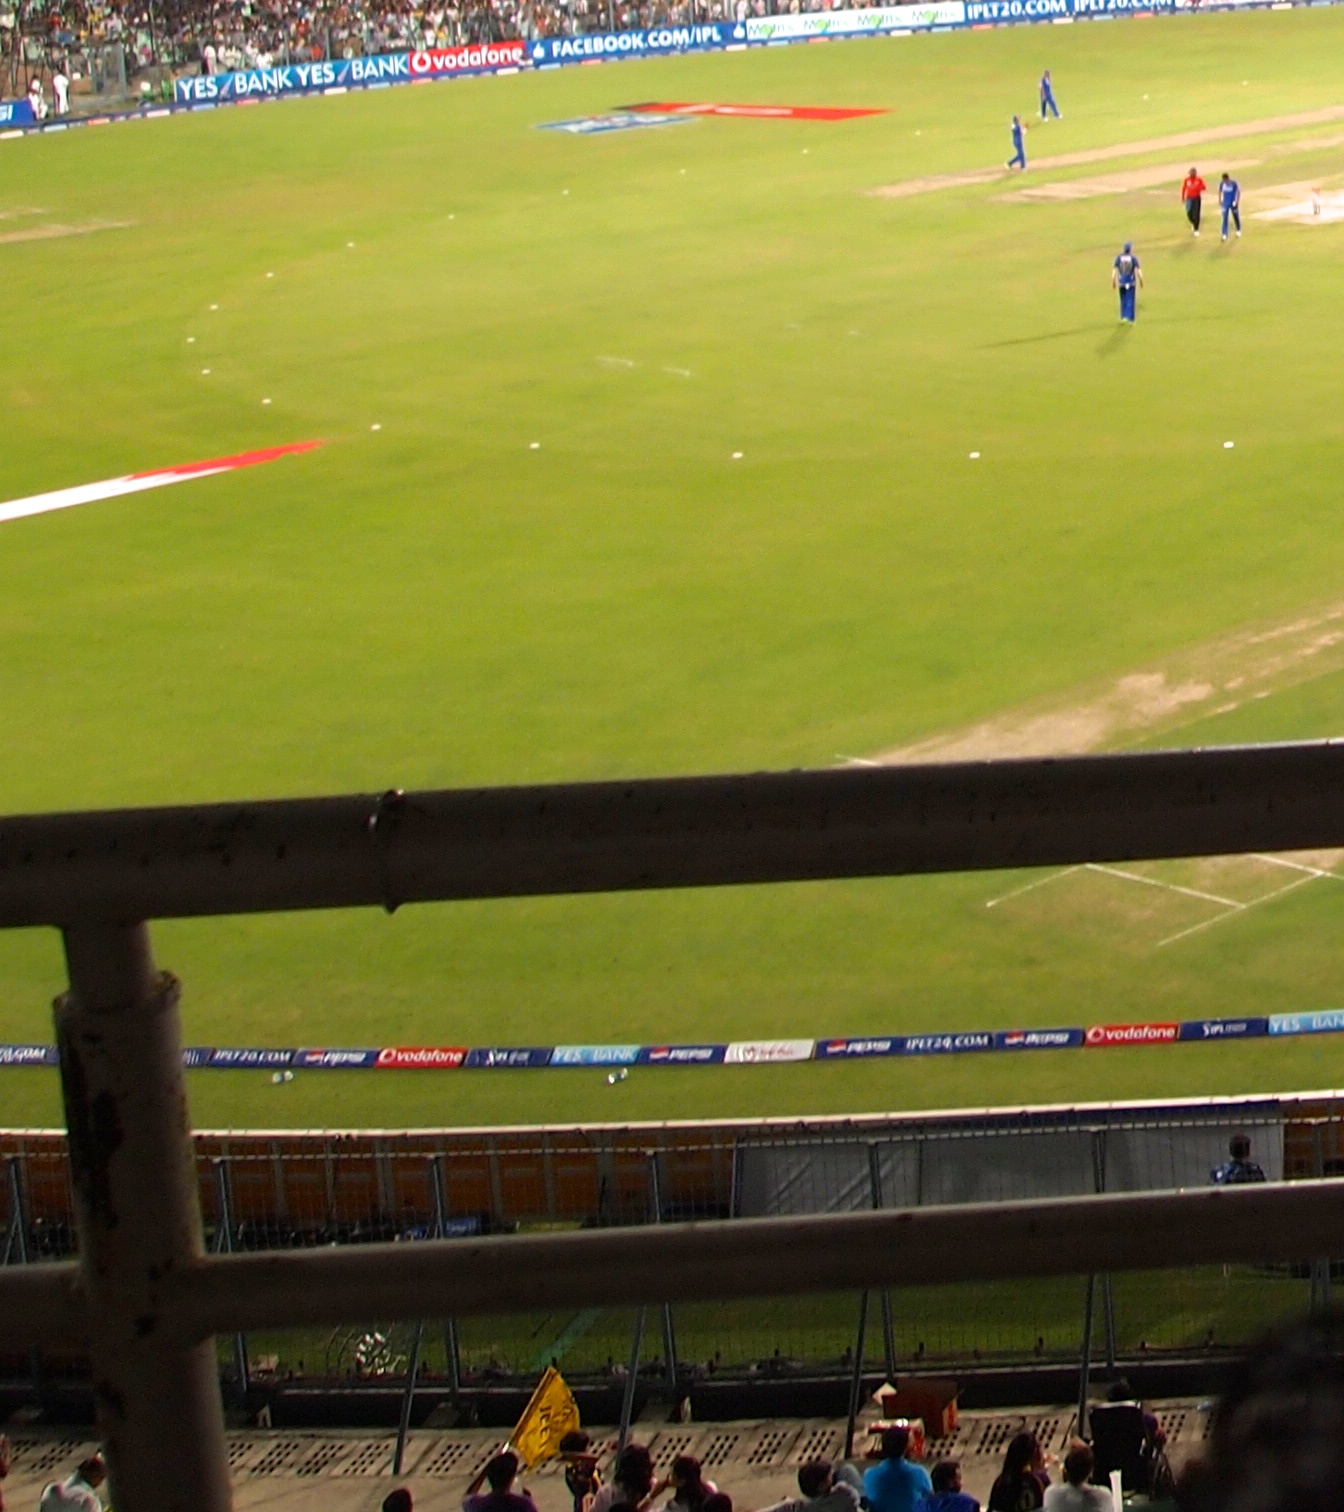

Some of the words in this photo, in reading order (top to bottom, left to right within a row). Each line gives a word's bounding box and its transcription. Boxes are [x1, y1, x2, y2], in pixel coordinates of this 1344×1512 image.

[552, 25, 720, 58] FACEBOOK.COM/IPL
[430, 47, 523, 70] vodafone
[298, 62, 334, 85] YES
[352, 54, 409, 79] BANK
[179, 77, 218, 100] YES
[234, 68, 292, 94] BANK
[1270, 1017, 1300, 1032] YES
[1024, 1033, 1069, 1045] PEPSI
[1106, 1026, 1176, 1041] vodafone
[846, 1041, 891, 1052] PEPSI
[397, 1050, 463, 1063] vodafone
[555, 1049, 581, 1062] YES
[594, 1047, 638, 1061] BANK
[669, 1049, 712, 1060] PEPSI
